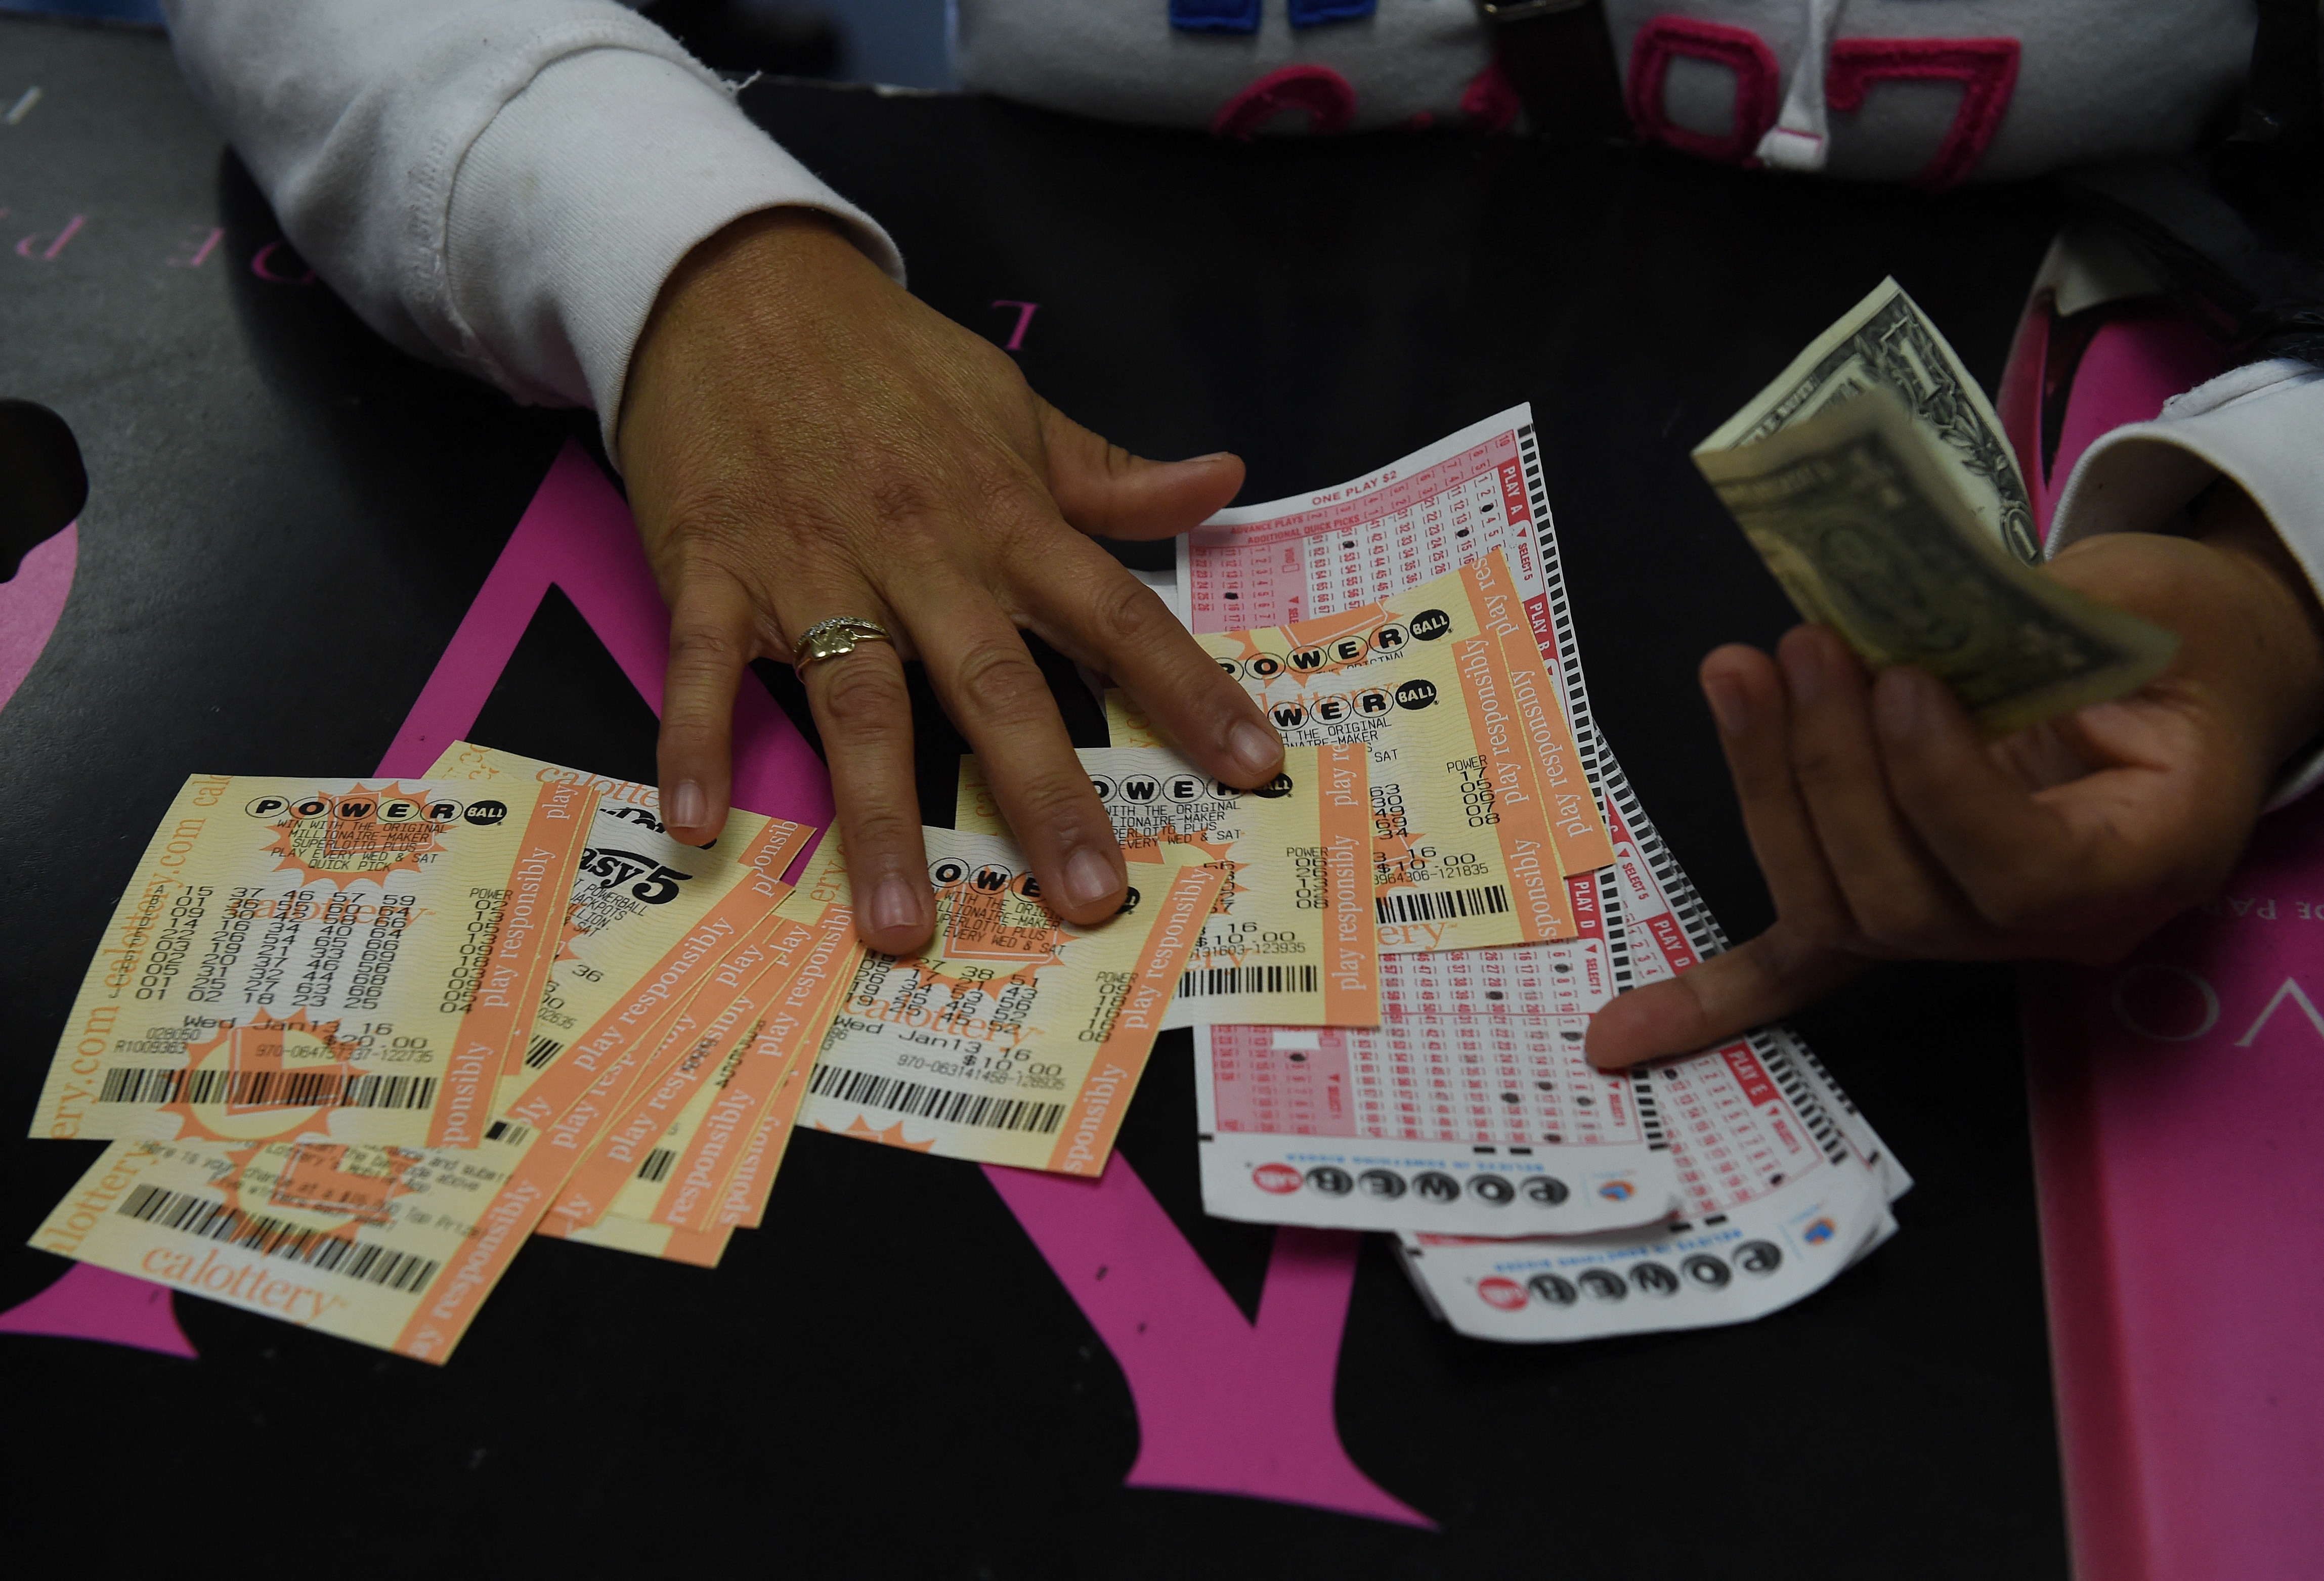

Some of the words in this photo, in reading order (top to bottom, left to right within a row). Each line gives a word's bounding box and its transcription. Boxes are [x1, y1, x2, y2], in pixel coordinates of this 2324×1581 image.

[1312, 492, 1341, 505] ONE
[1346, 478, 1378, 498] PLAY
[1384, 470, 1397, 482] $2
[1503, 465, 1521, 501] PLAY
[1511, 505, 1523, 515] A
[1275, 515, 1304, 528] PLAYS
[1304, 522, 1331, 534] QUICK
[1333, 514, 1361, 527] PICKS
[1518, 542, 1531, 572] SELECT
[1484, 595, 1519, 637] play
[1530, 601, 1548, 633] PLAY
[1462, 639, 1511, 760] responsibly
[1297, 728, 1319, 742] THE
[1327, 717, 1393, 737] ORIGINAL
[1511, 670, 1565, 786] responsibly
[1374, 749, 1399, 763] SAT
[1446, 755, 1488, 774] POWER
[1460, 766, 1487, 782] 17
[1495, 764, 1530, 805] play
[1326, 767, 1358, 807] play
[1370, 783, 1400, 797] 63
[1460, 778, 1492, 794] 05
[1464, 789, 1495, 805] 06
[542, 784, 579, 820] play
[1145, 804, 1169, 816] THE
[1176, 801, 1242, 815] ORIGINAL
[1371, 795, 1403, 808] 30
[1466, 801, 1495, 816] 07
[277, 818, 305, 828] WIN
[311, 820, 345, 831] WITH
[353, 821, 376, 832] THE
[383, 822, 448, 835] ORIGINAL
[1184, 821, 1218, 832] PLUS
[1376, 816, 1407, 829] 69
[1469, 812, 1501, 827] 08
[1555, 792, 1593, 839] play
[288, 828, 431, 843] MILLIONAIRE-MAKER
[292, 838, 377, 852] SUPERLOTTO
[384, 841, 417, 853] PLUS
[1118, 837, 1158, 850] EVERY
[1168, 833, 1193, 846] WED
[1217, 828, 1242, 841] SAT
[271, 846, 306, 859] PLAY
[312, 849, 355, 861] EVERY
[363, 851, 389, 862] WED
[410, 853, 439, 864] SAT
[1286, 847, 1329, 858] POWER
[1406, 846, 1437, 859] 16
[308, 858, 349, 871] QUICK
[357, 861, 393, 872] PICK
[1622, 862, 1646, 892] SELECT
[185, 885, 215, 897] 15
[231, 887, 265, 898] 37
[282, 890, 316, 901] 46
[333, 892, 366, 903] 57
[383, 894, 416, 906] 59
[469, 888, 513, 900] POWER
[583, 883, 649, 917] POWERBALL
[944, 891, 978, 905] WITH
[987, 896, 1010, 907] THE
[1328, 835, 1364, 943] responsibly
[1574, 881, 1594, 912] PLAY
[475, 899, 508, 911] 02
[480, 964, 520, 1007] play
[500, 846, 556, 958] responsibly
[1012, 927, 1048, 941] PLUS
[1228, 921, 1258, 933] 16
[1654, 920, 1683, 951] PLAY
[942, 926, 986, 943] EVERY
[991, 935, 1018, 949] WED
[1039, 943, 1066, 956] SAT
[1121, 984, 1163, 1030] play
[1146, 868, 1215, 979] responsibly
[572, 963, 605, 983] 36
[715, 943, 766, 989] play
[912, 957, 945, 971] 27
[961, 966, 995, 980] 38
[1010, 974, 1040, 988] 51
[1331, 947, 1367, 992] play
[1585, 959, 1600, 988] SELECT
[756, 1011, 800, 1058] play
[785, 904, 854, 1008] responsibl
[135, 988, 166, 1000] 01
[187, 989, 223, 1002] 02
[244, 992, 275, 1005] 18
[290, 994, 327, 1007] 23
[343, 997, 379, 1009] 25
[573, 1024, 625, 1072] play
[618, 915, 735, 1024] responsibly
[183, 1015, 238, 1029] Wed
[362, 1022, 394, 1036] 16
[834, 1015, 884, 1035] Wed
[1002, 1048, 1032, 1062] 16
[608, 1112, 658, 1163] play
[667, 1089, 756, 1224] responsibly
[432, 1178, 544, 1320] responsibly
[141, 1244, 338, 1327] calottery
